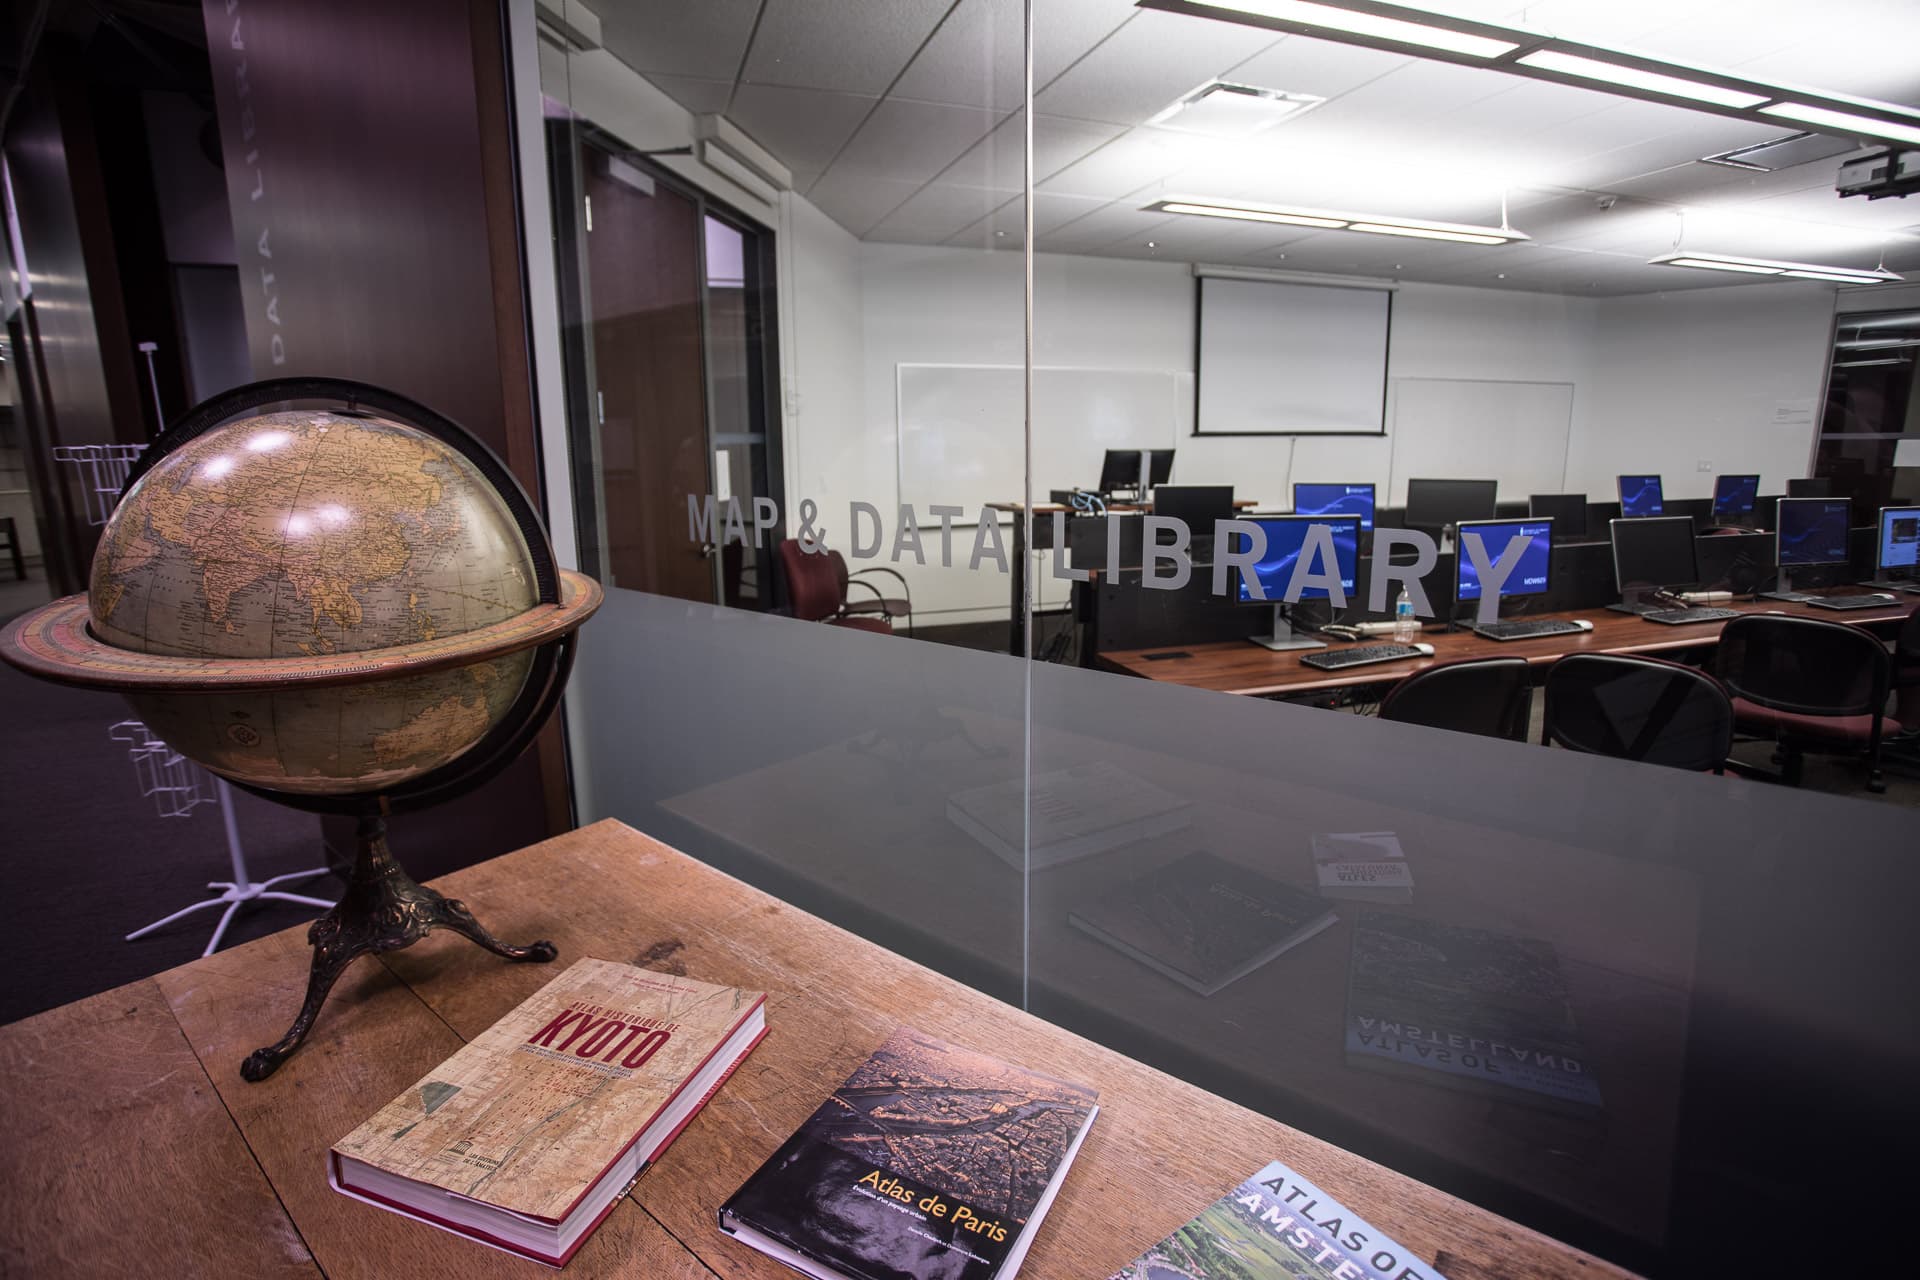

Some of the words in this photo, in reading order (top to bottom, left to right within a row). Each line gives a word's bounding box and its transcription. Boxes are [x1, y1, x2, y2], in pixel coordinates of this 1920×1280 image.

[687, 494, 778, 549] MAP
[798, 498, 829, 556] &
[850, 501, 1009, 574] DATA
[1053, 511, 1534, 624] LIBRARY
[528, 1009, 671, 1069] KYOTO
[571, 1001, 602, 1015] ATLAS
[603, 1009, 664, 1029] HISTORIQUE
[665, 1023, 681, 1033] DE
[858, 1170, 915, 1203] Atlas
[918, 1195, 947, 1217] de
[950, 1206, 1008, 1242] Paris
[1236, 1193, 1376, 1280] AMSTE
[1260, 1176, 1369, 1252] ATLAS
